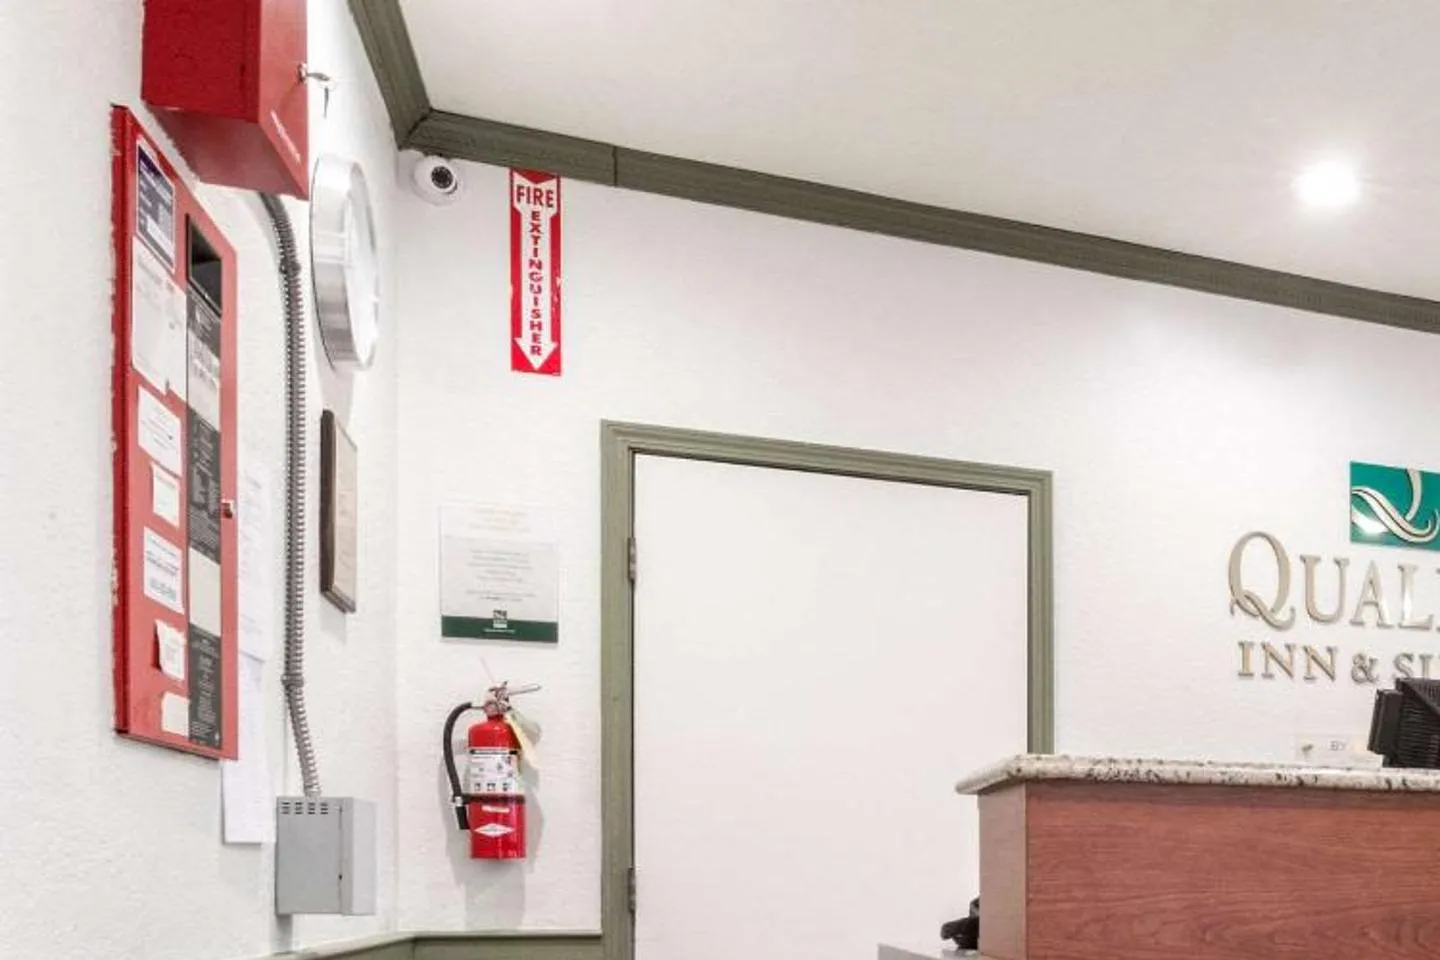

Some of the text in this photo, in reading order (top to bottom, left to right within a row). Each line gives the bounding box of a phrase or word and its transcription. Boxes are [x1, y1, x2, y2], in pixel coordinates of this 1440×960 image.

[516, 185, 554, 208] FIRE
[528, 210, 543, 356] EXTINGUISHER
[1238, 641, 1338, 682] INN
[1351, 653, 1379, 684] &
